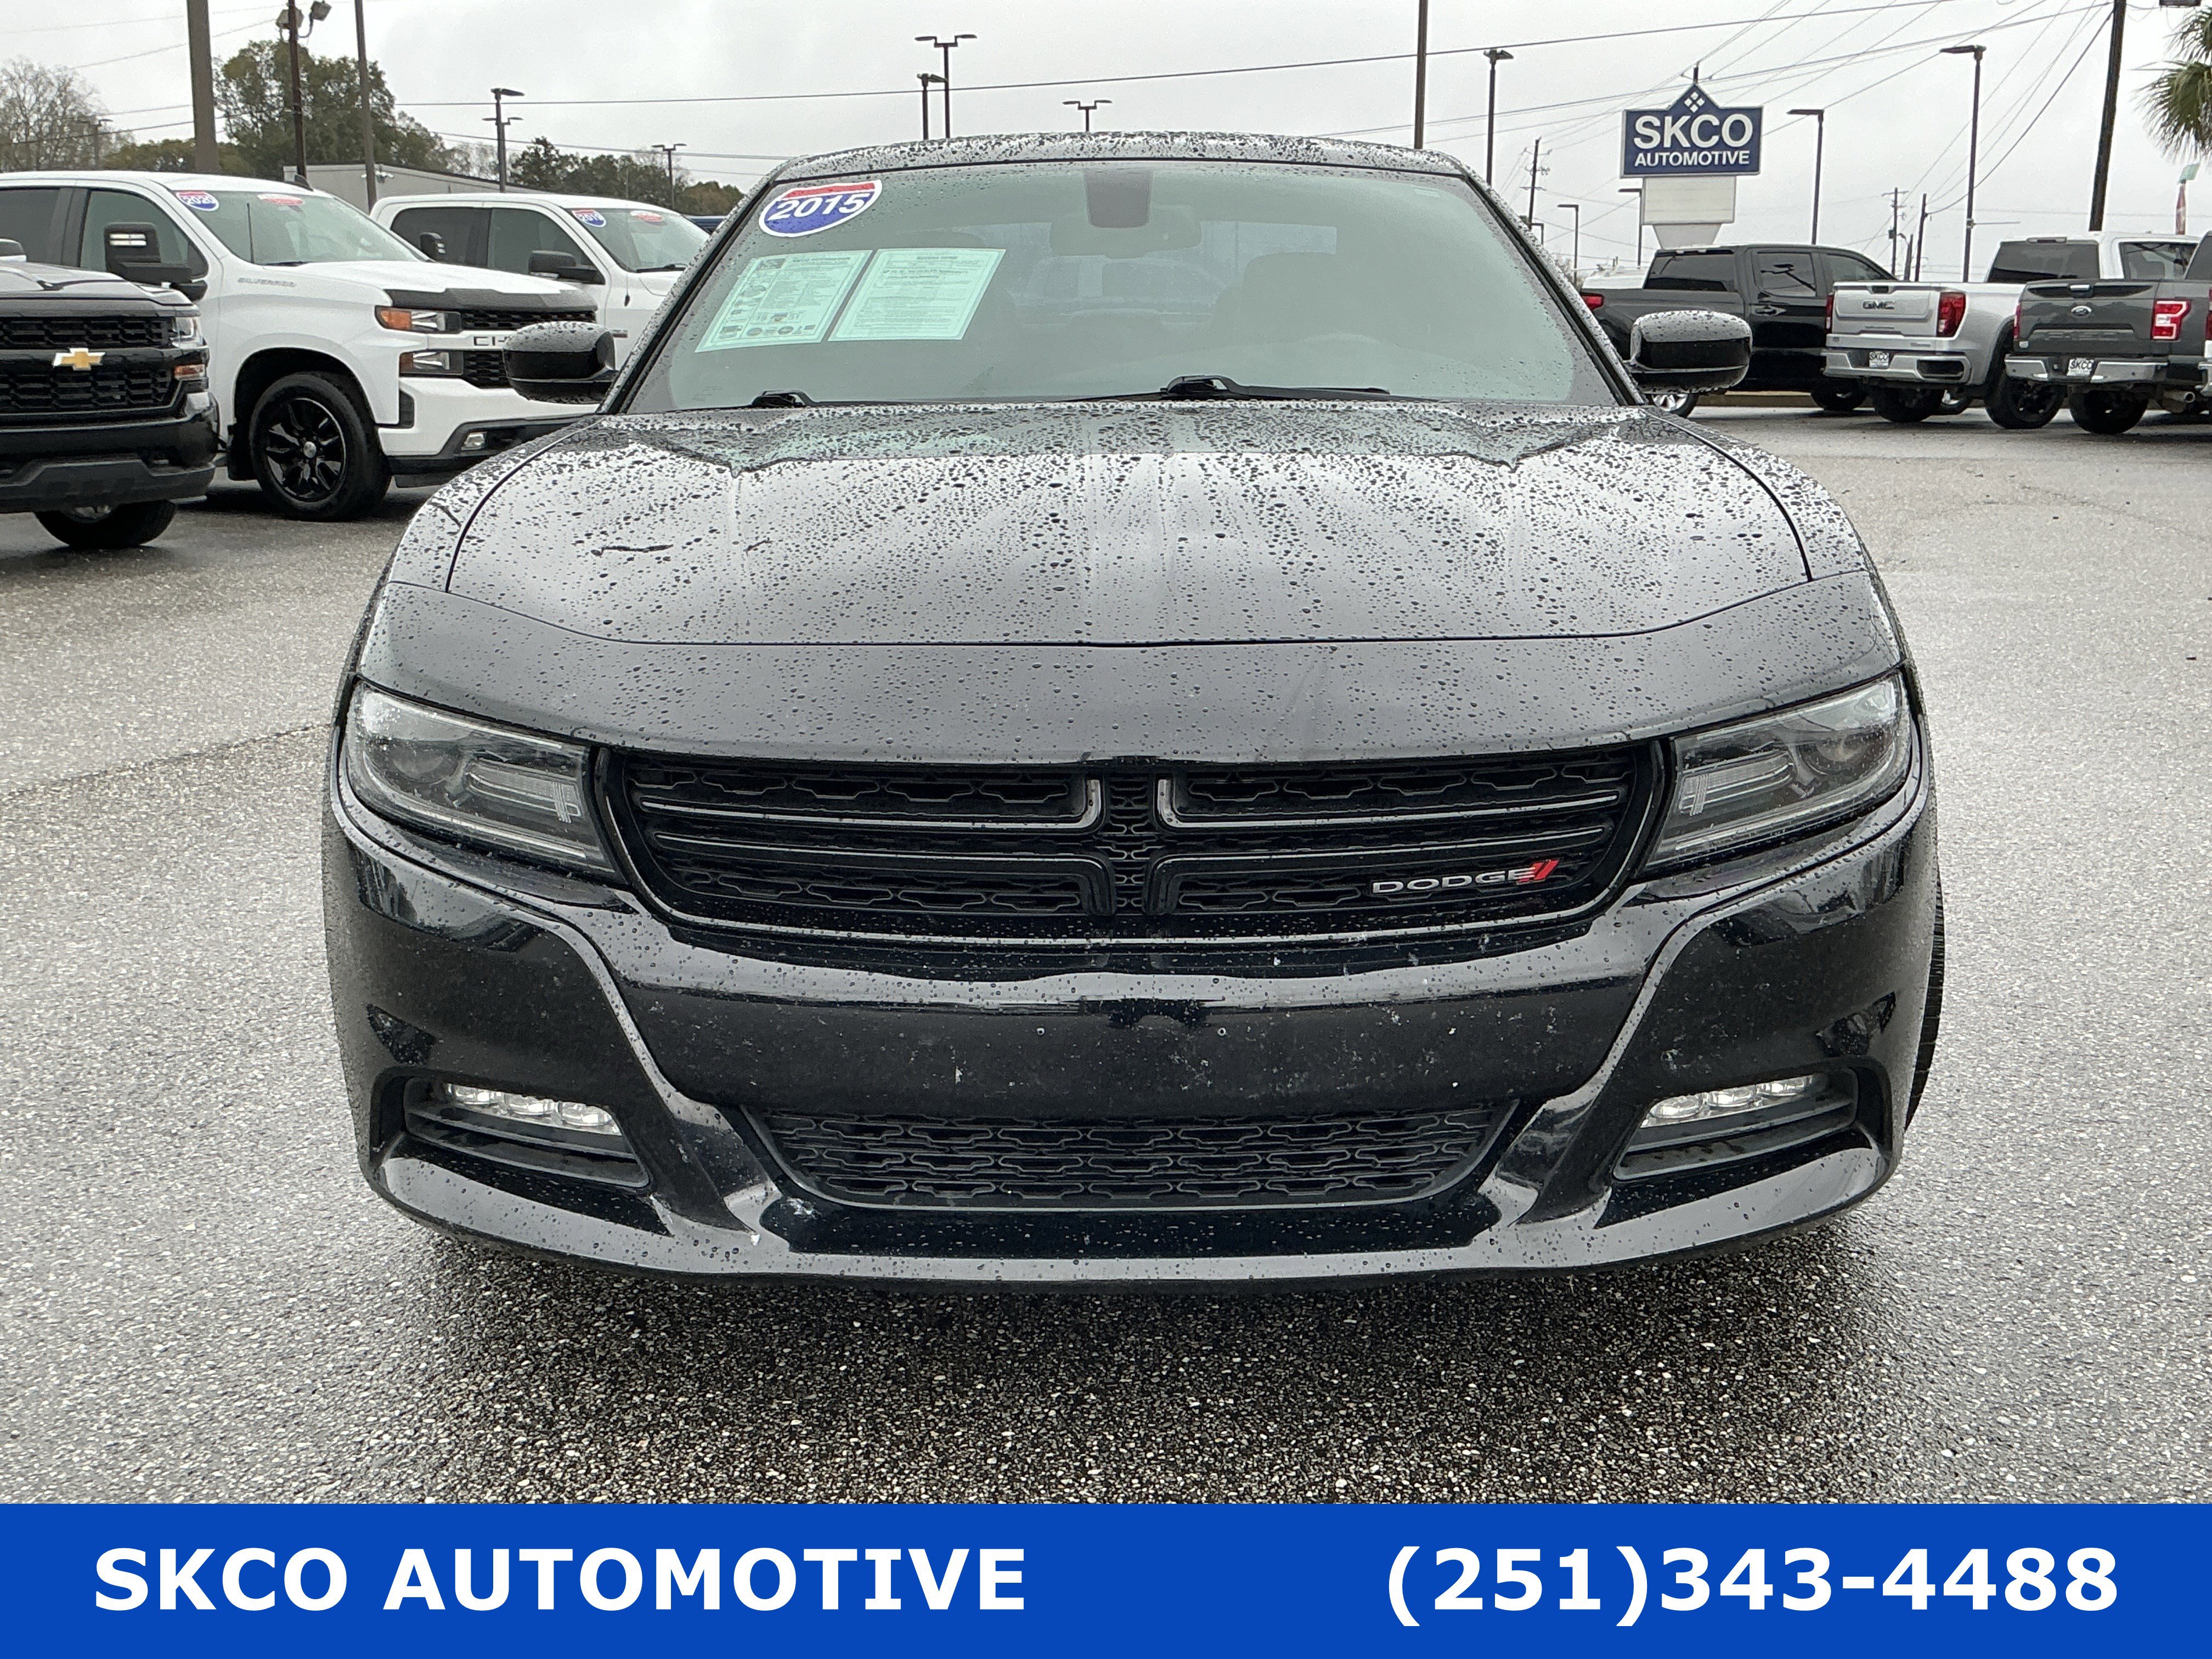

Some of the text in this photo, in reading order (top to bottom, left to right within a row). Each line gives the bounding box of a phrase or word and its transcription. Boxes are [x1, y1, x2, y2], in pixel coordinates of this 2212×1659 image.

[1633, 114, 1753, 149] SKCO
[1634, 150, 1751, 167] AUTOMOTIVE
[767, 193, 871, 221] 2015
[1862, 301, 1895, 310] GMC
[1372, 866, 1536, 894] DODGE
